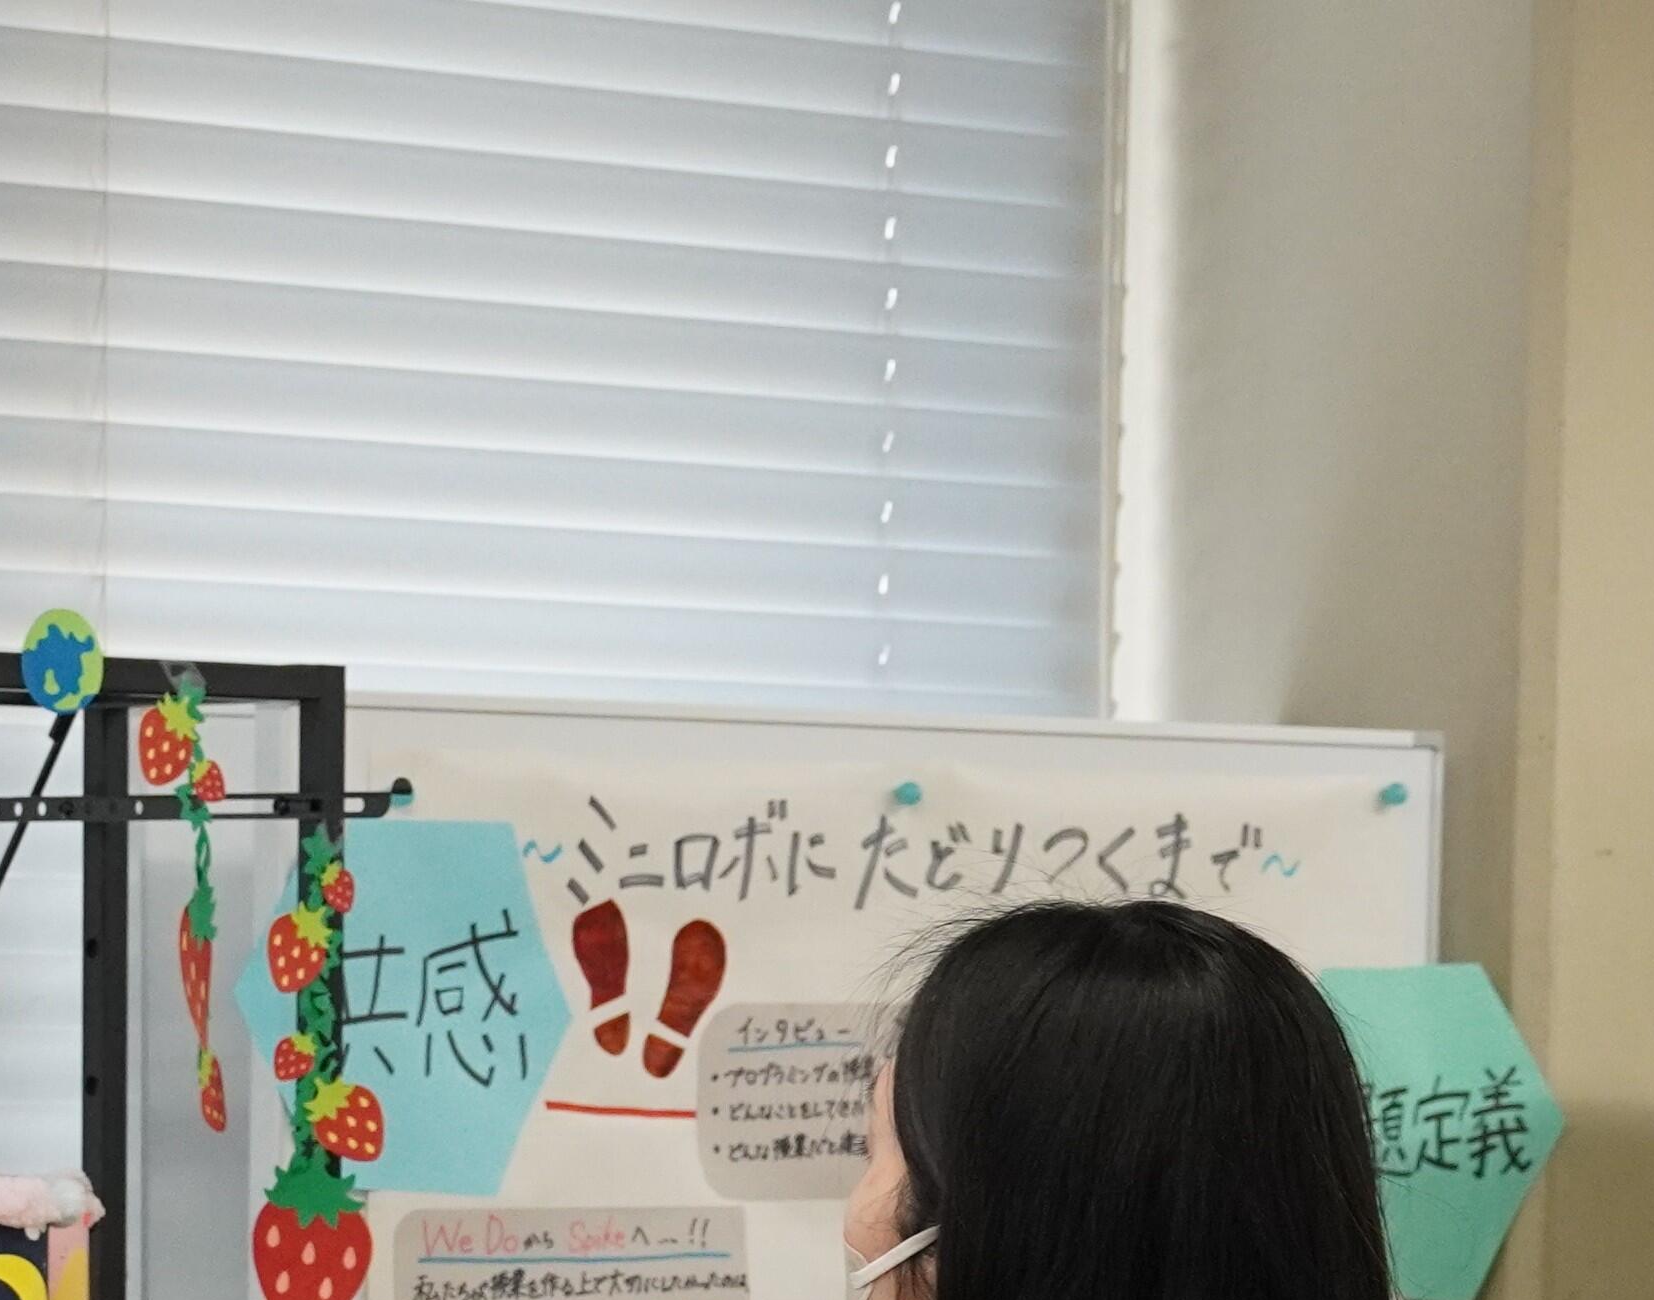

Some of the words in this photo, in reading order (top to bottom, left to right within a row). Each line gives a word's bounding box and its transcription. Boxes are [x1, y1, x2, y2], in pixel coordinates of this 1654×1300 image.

[341, 908, 528, 1087] 共感
[737, 1016, 851, 1044] インタビュー
[421, 1217, 474, 1257] We
